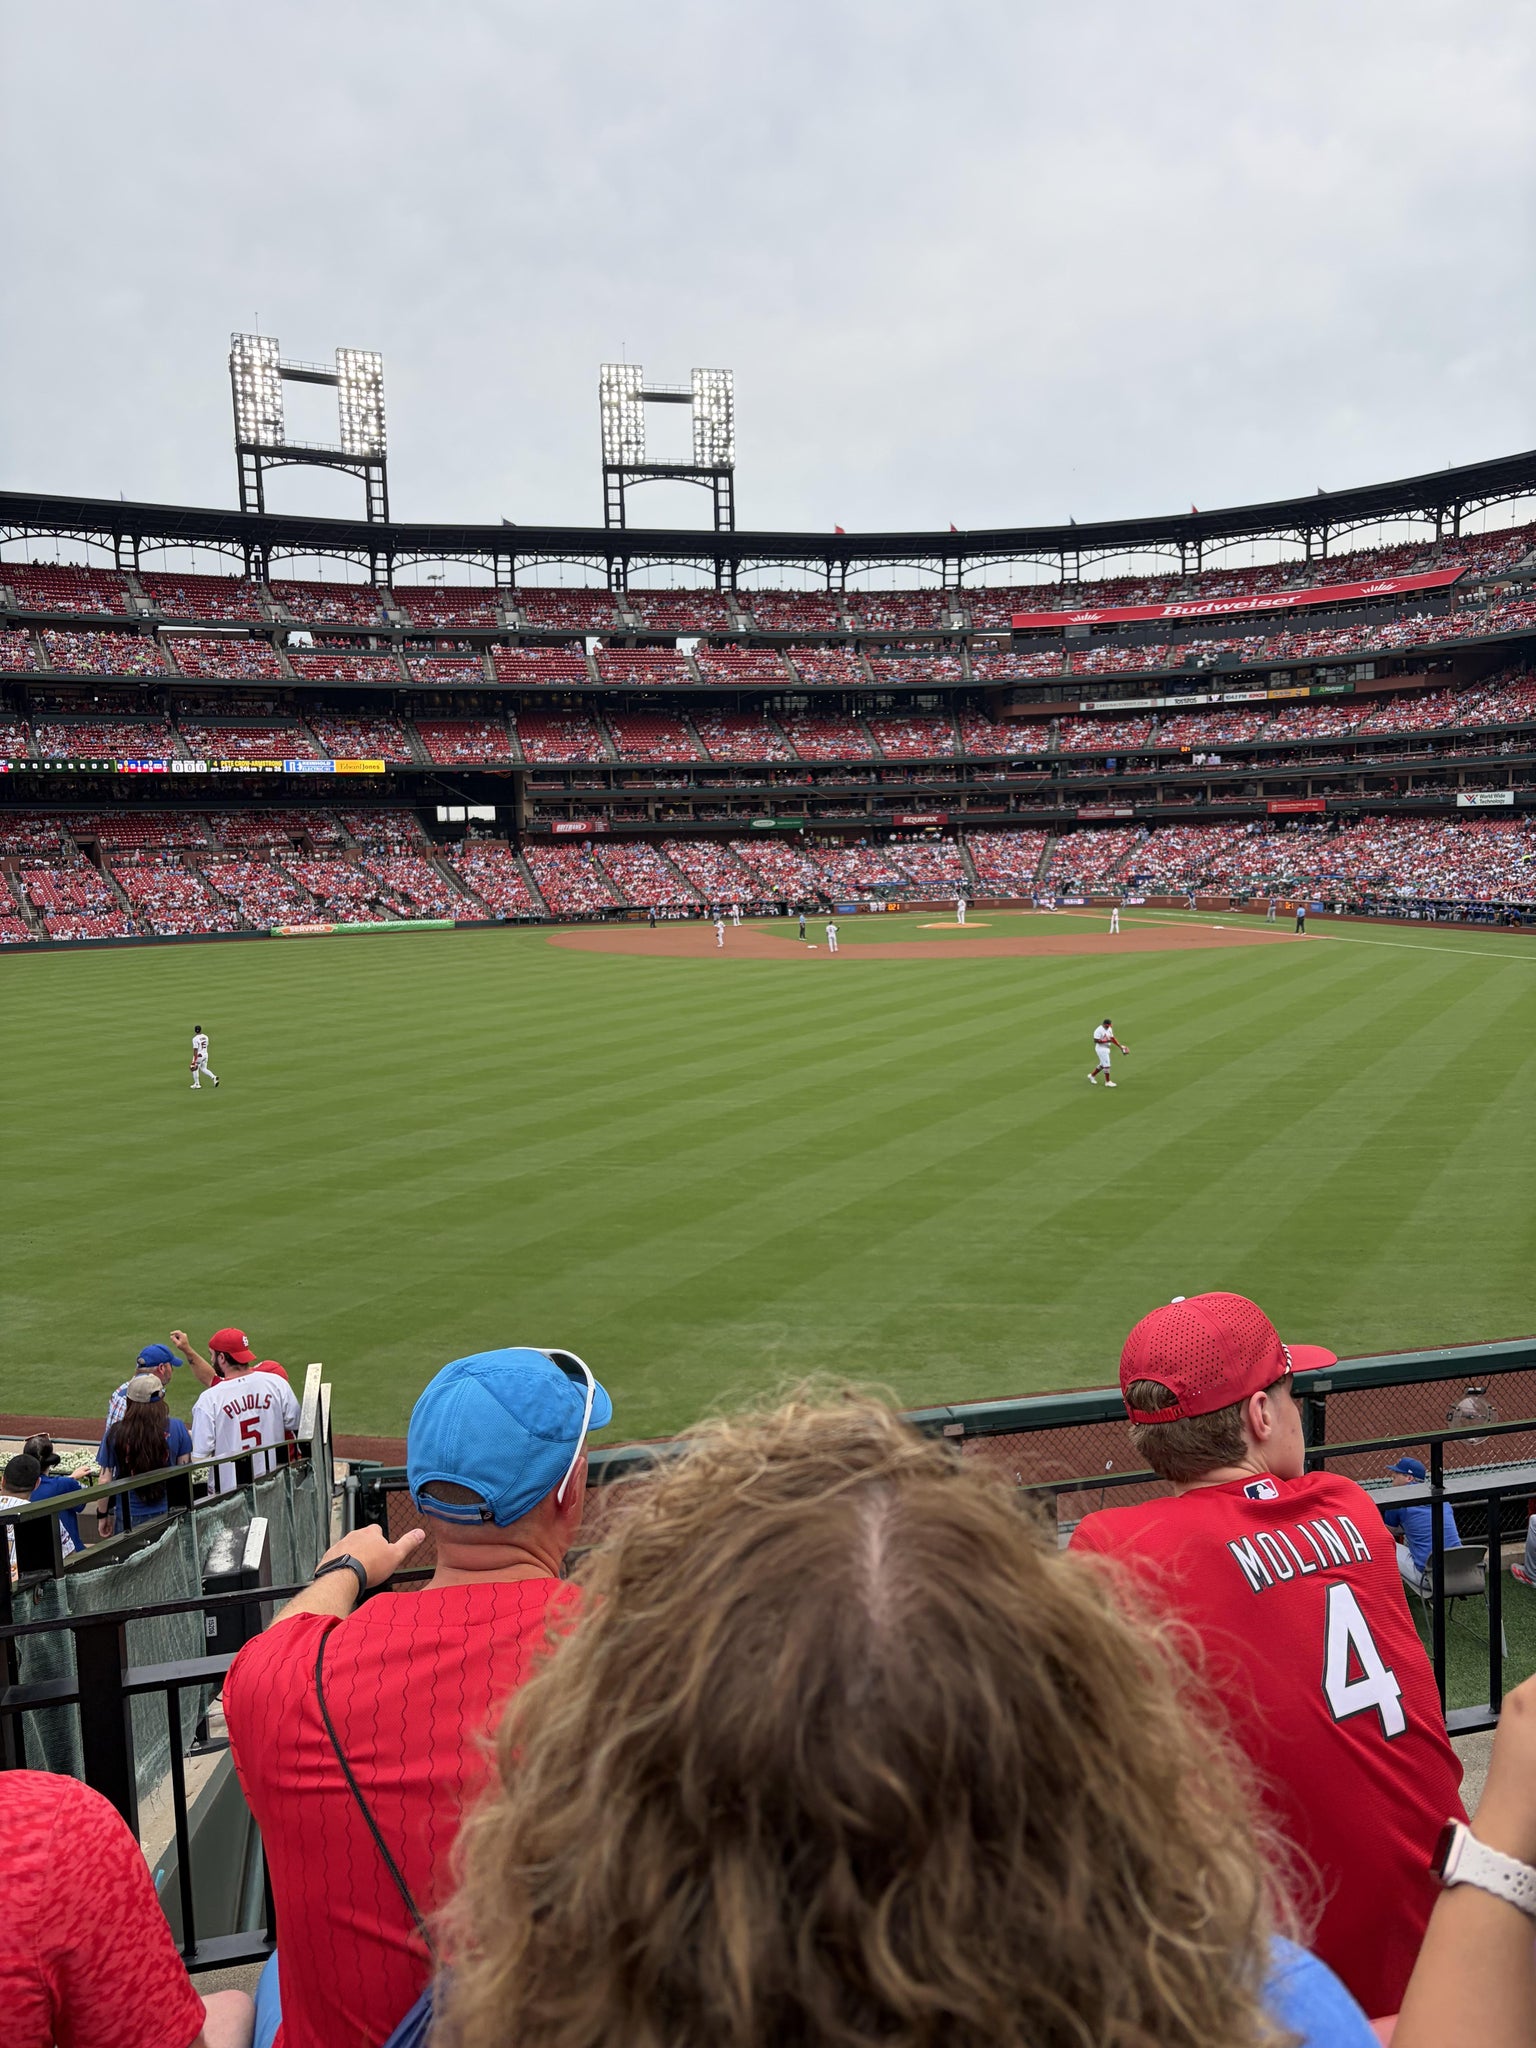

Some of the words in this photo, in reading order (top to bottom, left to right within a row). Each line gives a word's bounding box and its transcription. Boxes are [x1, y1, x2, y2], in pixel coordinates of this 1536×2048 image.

[1161, 596, 1302, 615] Budweiser
[902, 816, 938, 825] EQUIFAX
[289, 925, 325, 933] SERVPRO
[223, 1393, 273, 1419] PUJOLS
[240, 1416, 262, 1451] 5
[1227, 1516, 1372, 1593] MOLINA
[1322, 1580, 1408, 1741] 4
